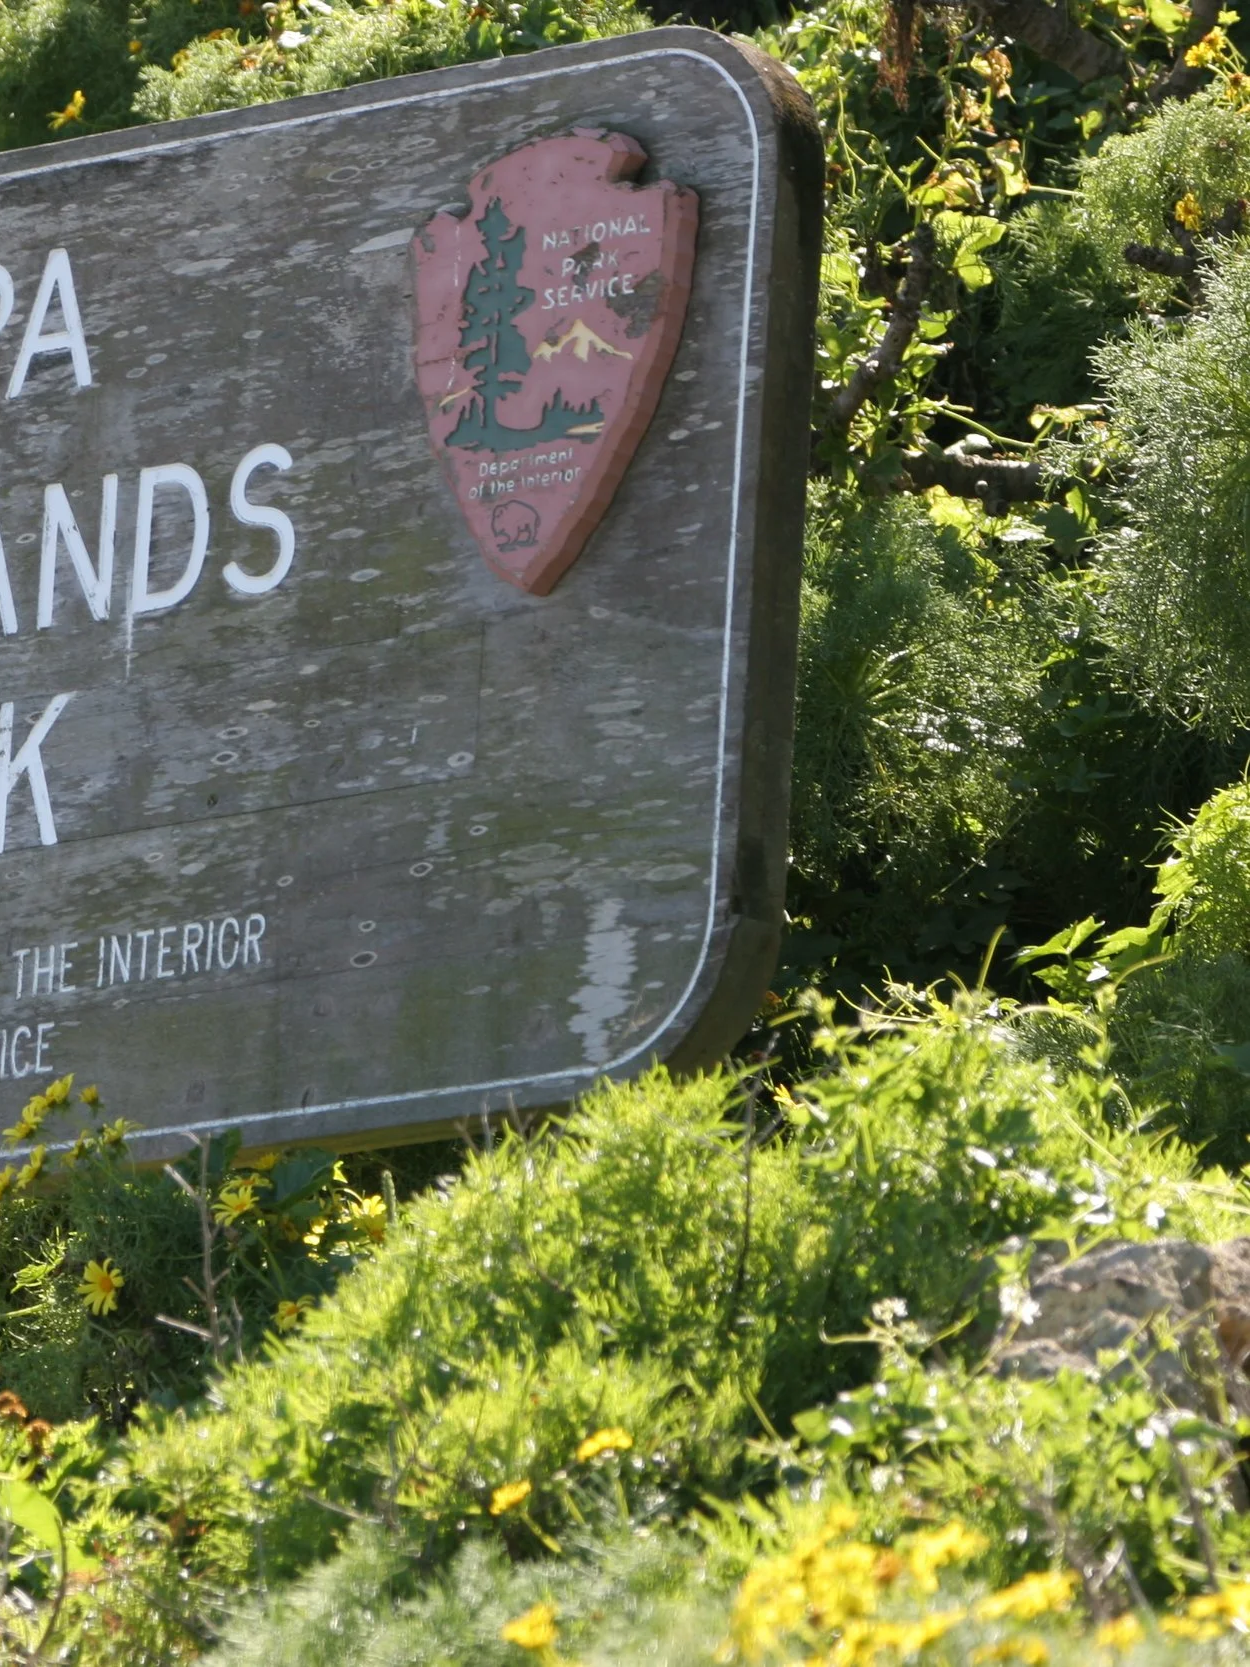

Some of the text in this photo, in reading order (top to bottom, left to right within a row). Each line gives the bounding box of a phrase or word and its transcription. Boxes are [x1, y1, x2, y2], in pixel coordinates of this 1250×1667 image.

[541, 274, 635, 310] SERVICE
[468, 480, 485, 500] of
[491, 479, 516, 495] the
[13, 942, 79, 1000] THE
[97, 913, 267, 988] INTERIOR
